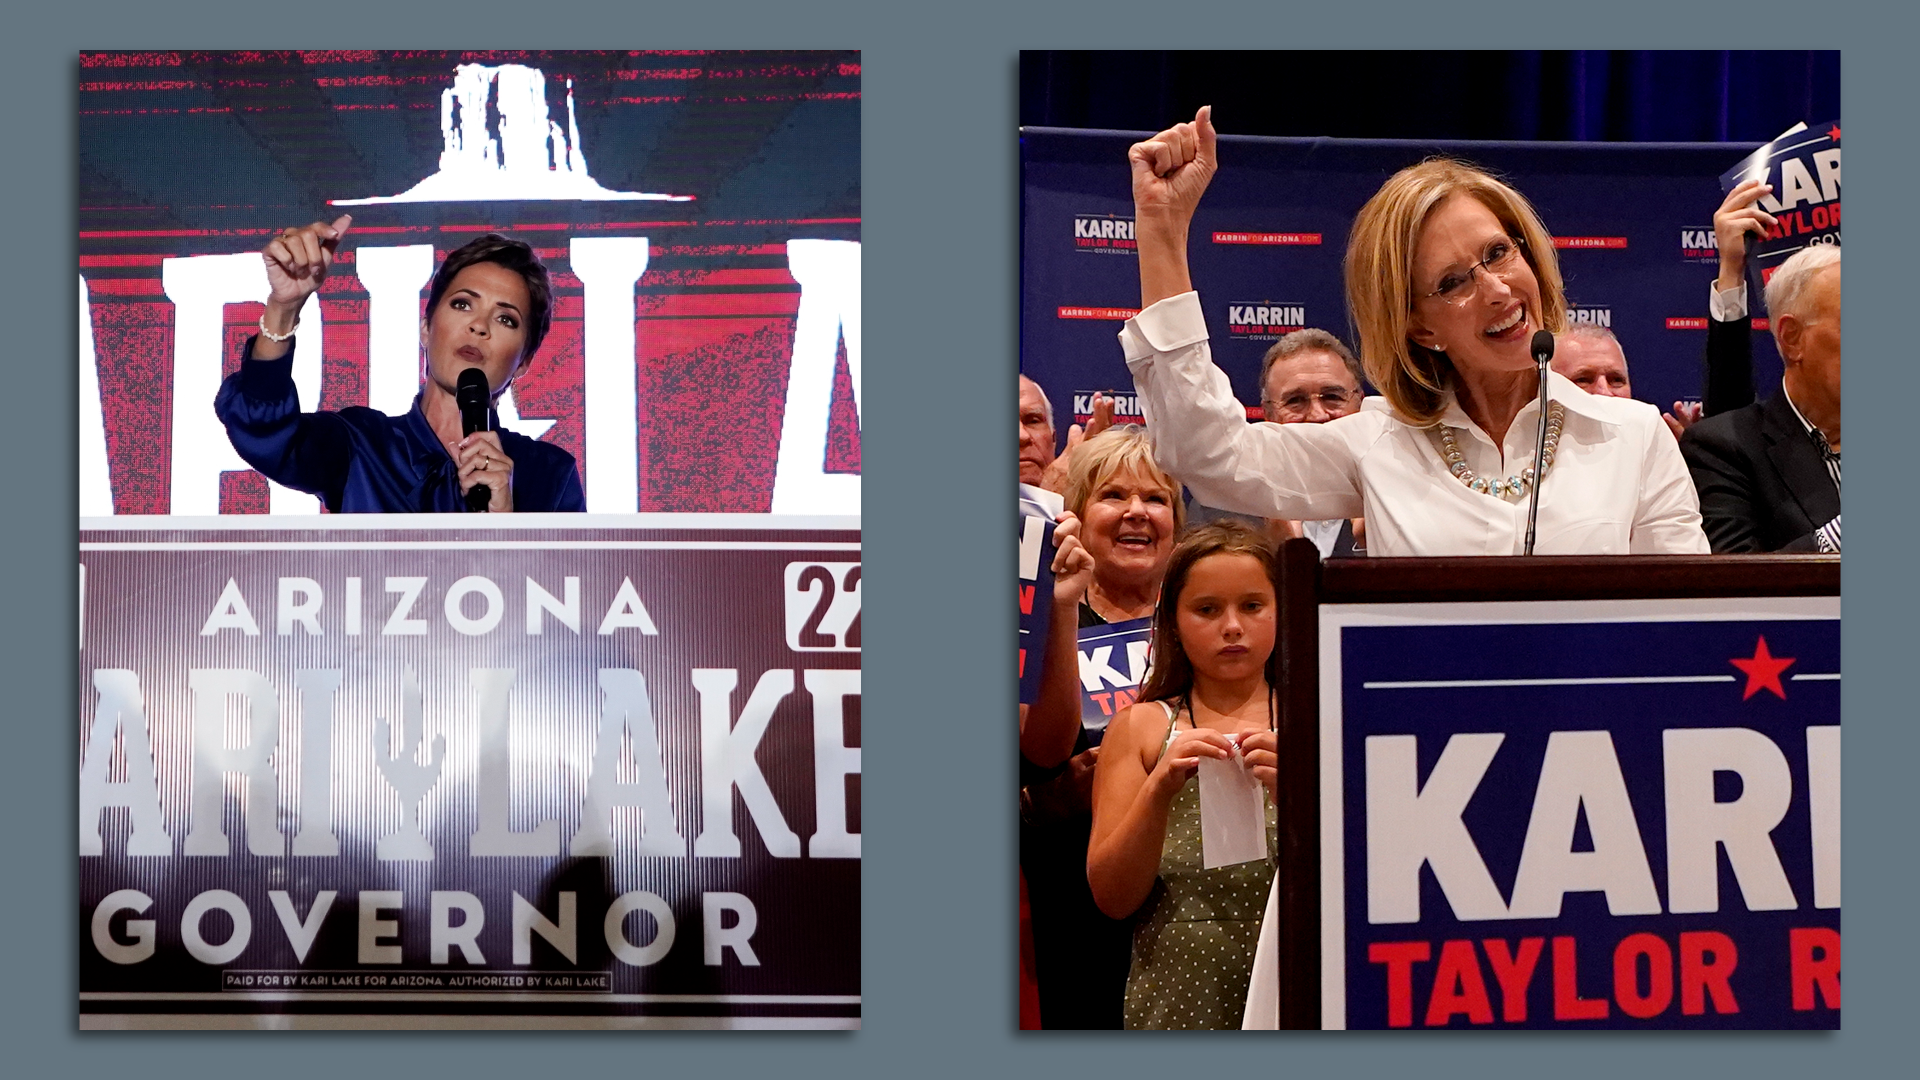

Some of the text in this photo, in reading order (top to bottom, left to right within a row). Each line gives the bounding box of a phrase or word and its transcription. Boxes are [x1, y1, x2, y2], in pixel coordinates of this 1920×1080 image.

[1076, 238, 1109, 247] TAYLOR
[1758, 203, 1841, 243] AYLOR
[1229, 306, 1304, 325] KARRIN
[1230, 325, 1264, 334] TAYLOR
[200, 576, 658, 635] ARIZONA
[470, 667, 861, 858] LAKE
[91, 889, 761, 966] GOVERNOR
[227, 975, 253, 986] PAID
[257, 975, 279, 986] FOR
[283, 975, 297, 986] BY
[301, 975, 328, 986] KARI
[332, 975, 360, 986] LAKE
[364, 976, 387, 986] FOR
[449, 976, 524, 987] AUTHORIZED
[527, 977, 541, 987] BY
[545, 977, 572, 987] KARI
[1367, 931, 1740, 1028] TAYLOR
